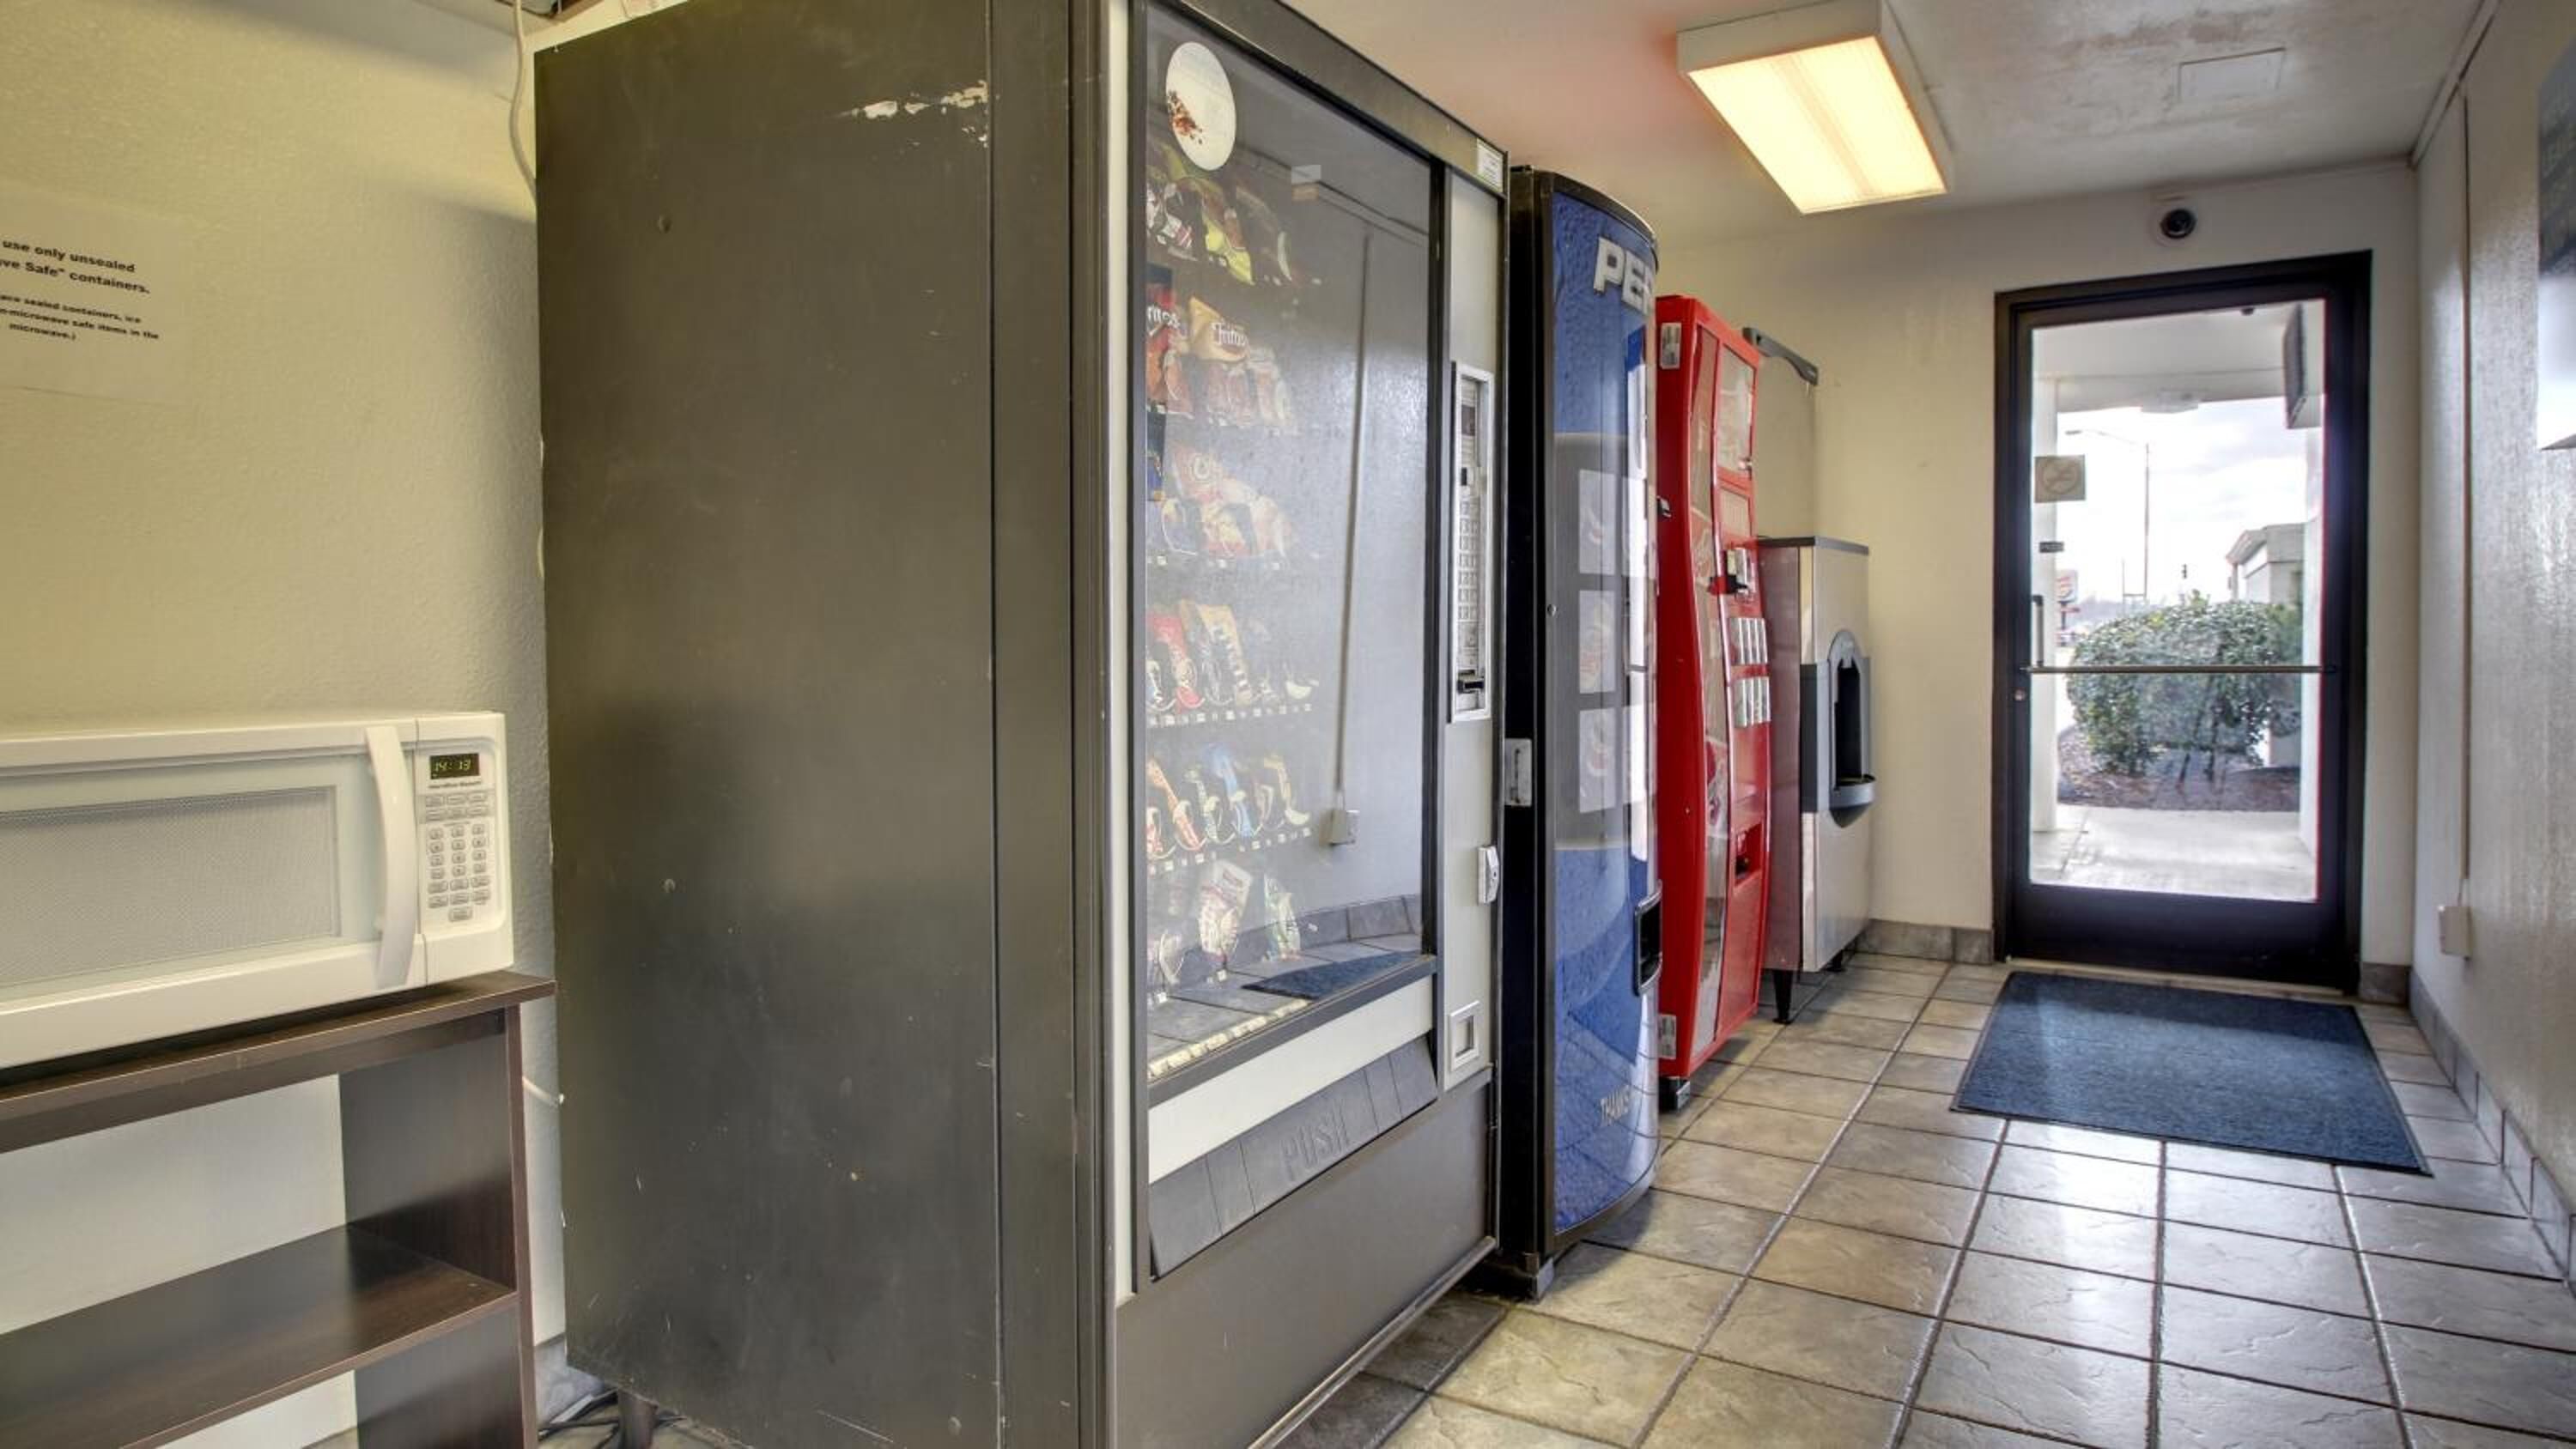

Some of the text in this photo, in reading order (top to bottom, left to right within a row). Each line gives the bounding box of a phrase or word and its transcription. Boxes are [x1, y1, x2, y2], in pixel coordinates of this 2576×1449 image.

[3, 240, 135, 273] use only unsealed
[24, 298, 60, 310] sealed
[72, 320, 94, 330] safe
[97, 324, 127, 335] items
[143, 331, 159, 340] the
[1279, 1101, 1351, 1181] PUSH
